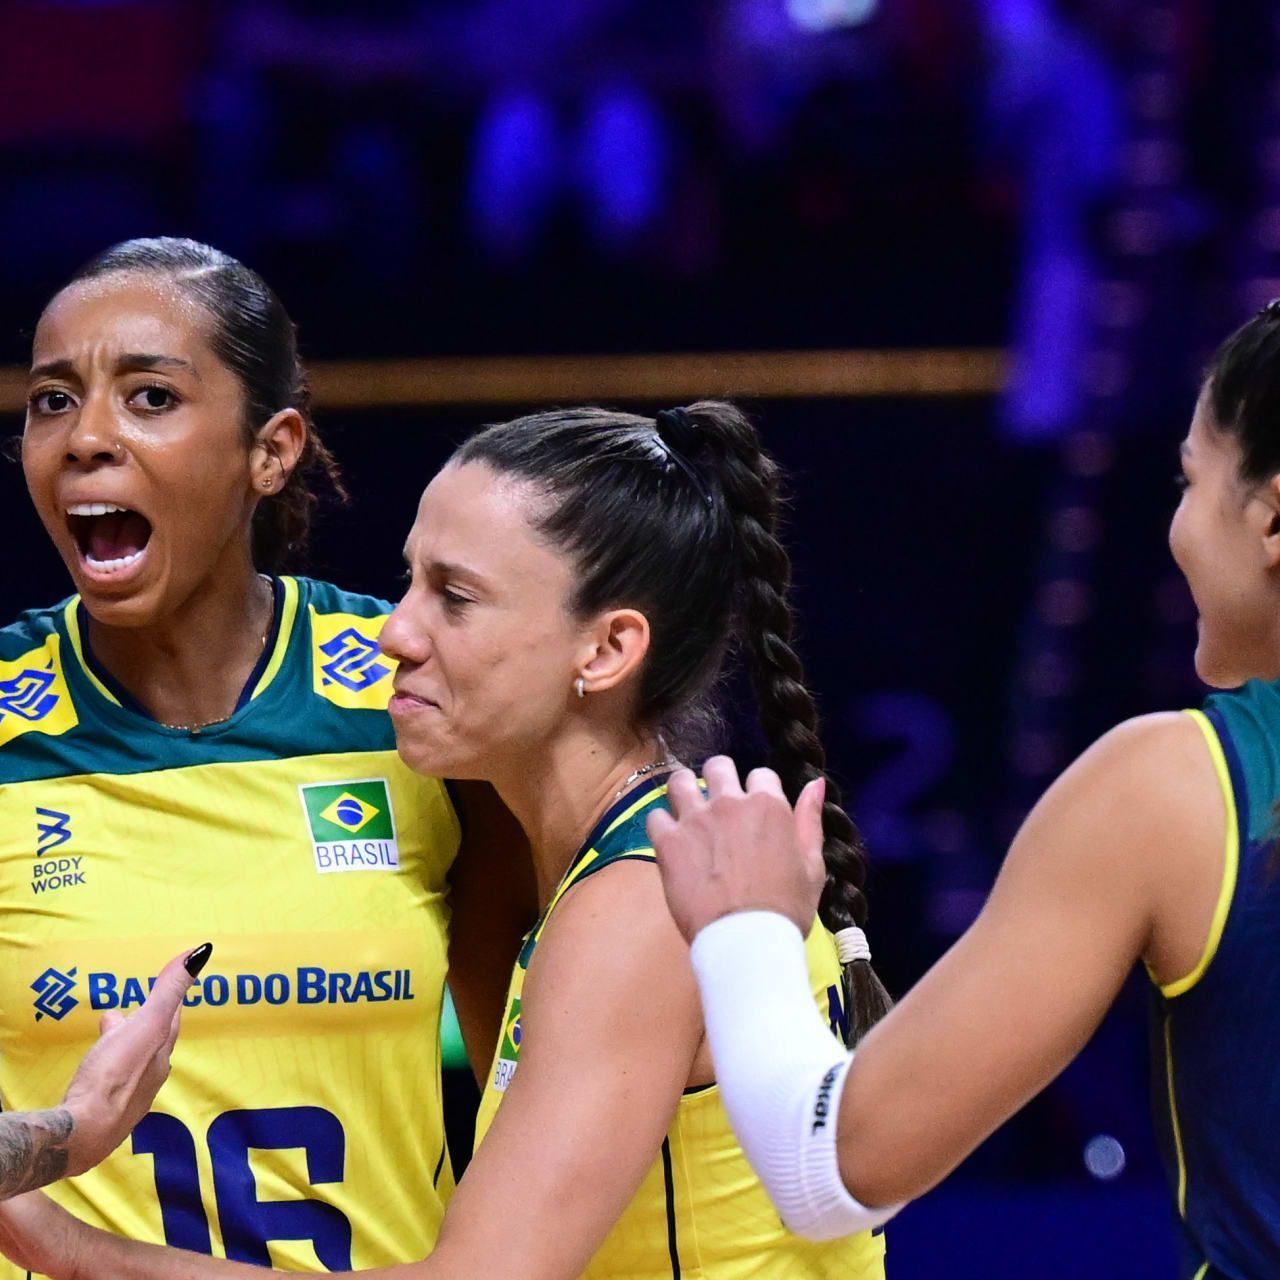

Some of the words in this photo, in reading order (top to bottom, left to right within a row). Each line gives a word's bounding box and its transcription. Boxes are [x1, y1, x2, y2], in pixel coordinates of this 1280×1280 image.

[33, 857, 83, 878] BODY
[316, 843, 397, 868] BRASIL
[31, 872, 87, 894] WORK
[88, 972, 230, 1010] BACO
[237, 974, 290, 1005] DO
[297, 967, 415, 1004] BRASIL
[131, 1106, 352, 1273] 16
